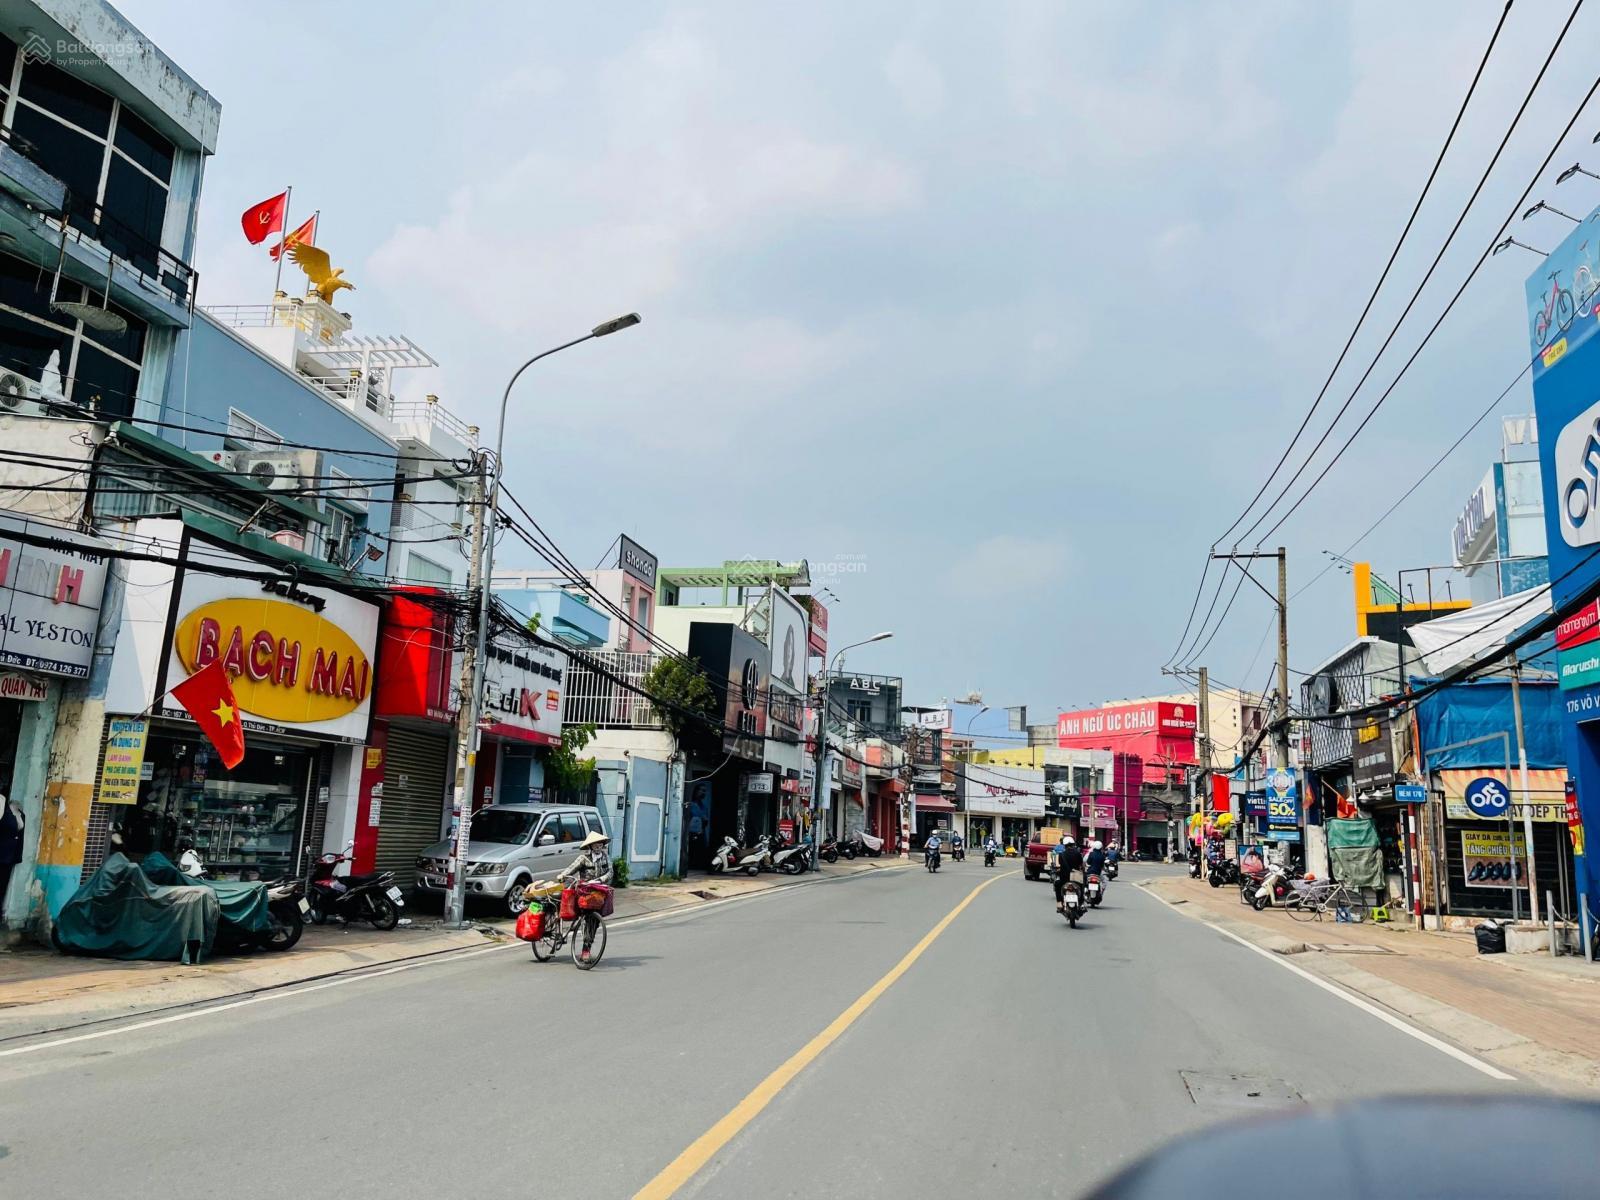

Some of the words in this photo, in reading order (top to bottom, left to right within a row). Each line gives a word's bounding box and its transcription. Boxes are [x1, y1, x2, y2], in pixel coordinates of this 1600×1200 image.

[25, 619, 95, 648] YESTON
[59, 664, 72, 674] 126
[74, 667, 87, 676] 377
[306, 646, 369, 704] MAI
[1566, 699, 1579, 713] 176
[1060, 719, 1080, 736] ANH
[1107, 711, 1121, 731] ÚC
[1124, 708, 1155, 729] CHÂU
[1270, 802, 1296, 816] 50%
